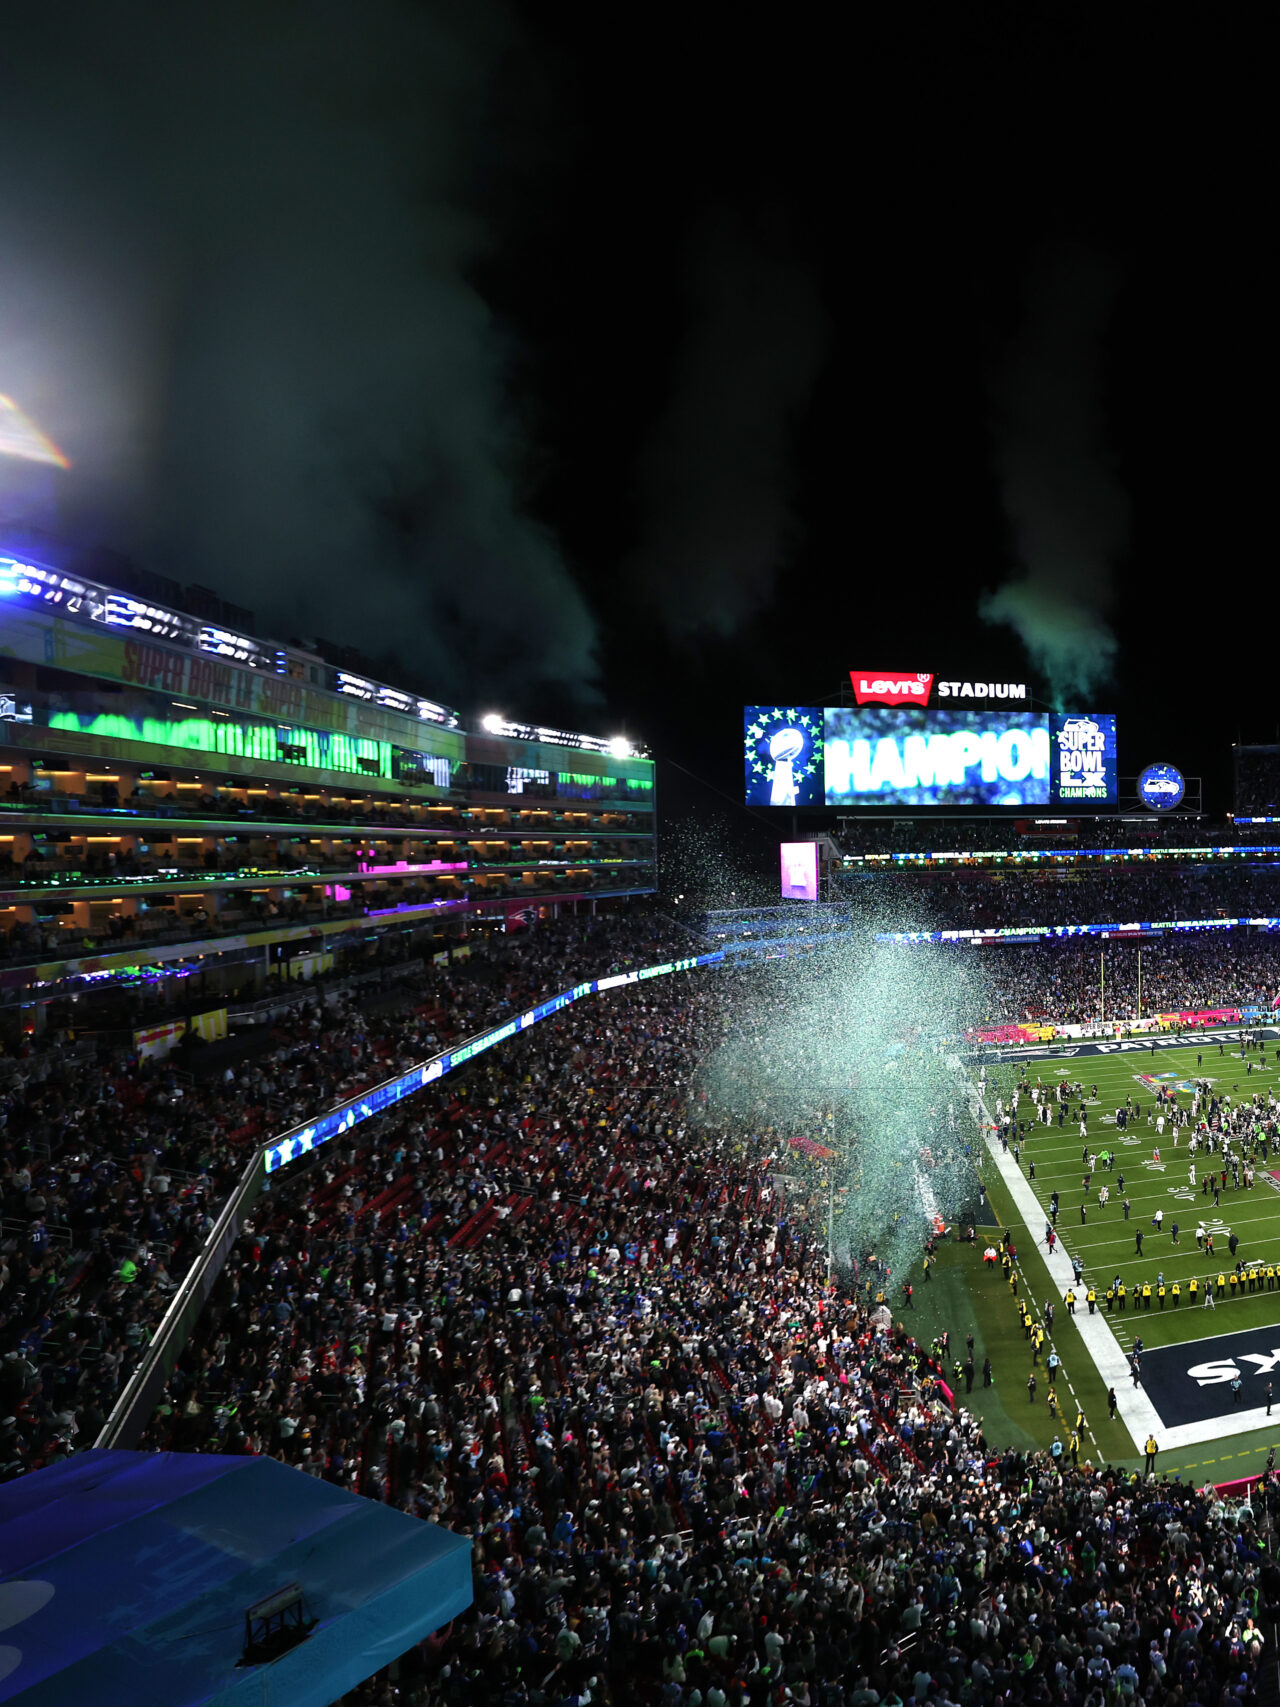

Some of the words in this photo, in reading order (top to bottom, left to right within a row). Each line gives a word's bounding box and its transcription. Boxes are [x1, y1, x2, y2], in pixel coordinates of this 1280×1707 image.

[122, 639, 184, 695] SUPER
[938, 681, 1026, 698] STADIUM
[1059, 731, 1105, 751] SUPER
[824, 727, 1049, 793] HAMPIO
[1059, 751, 1106, 772] BOWL
[1060, 772, 1107, 787] LX
[999, 927, 1048, 935] CHAMPIONS
[1096, 1032, 1254, 1053] PATRIOTS
[1198, 1218, 1231, 1235] 20
